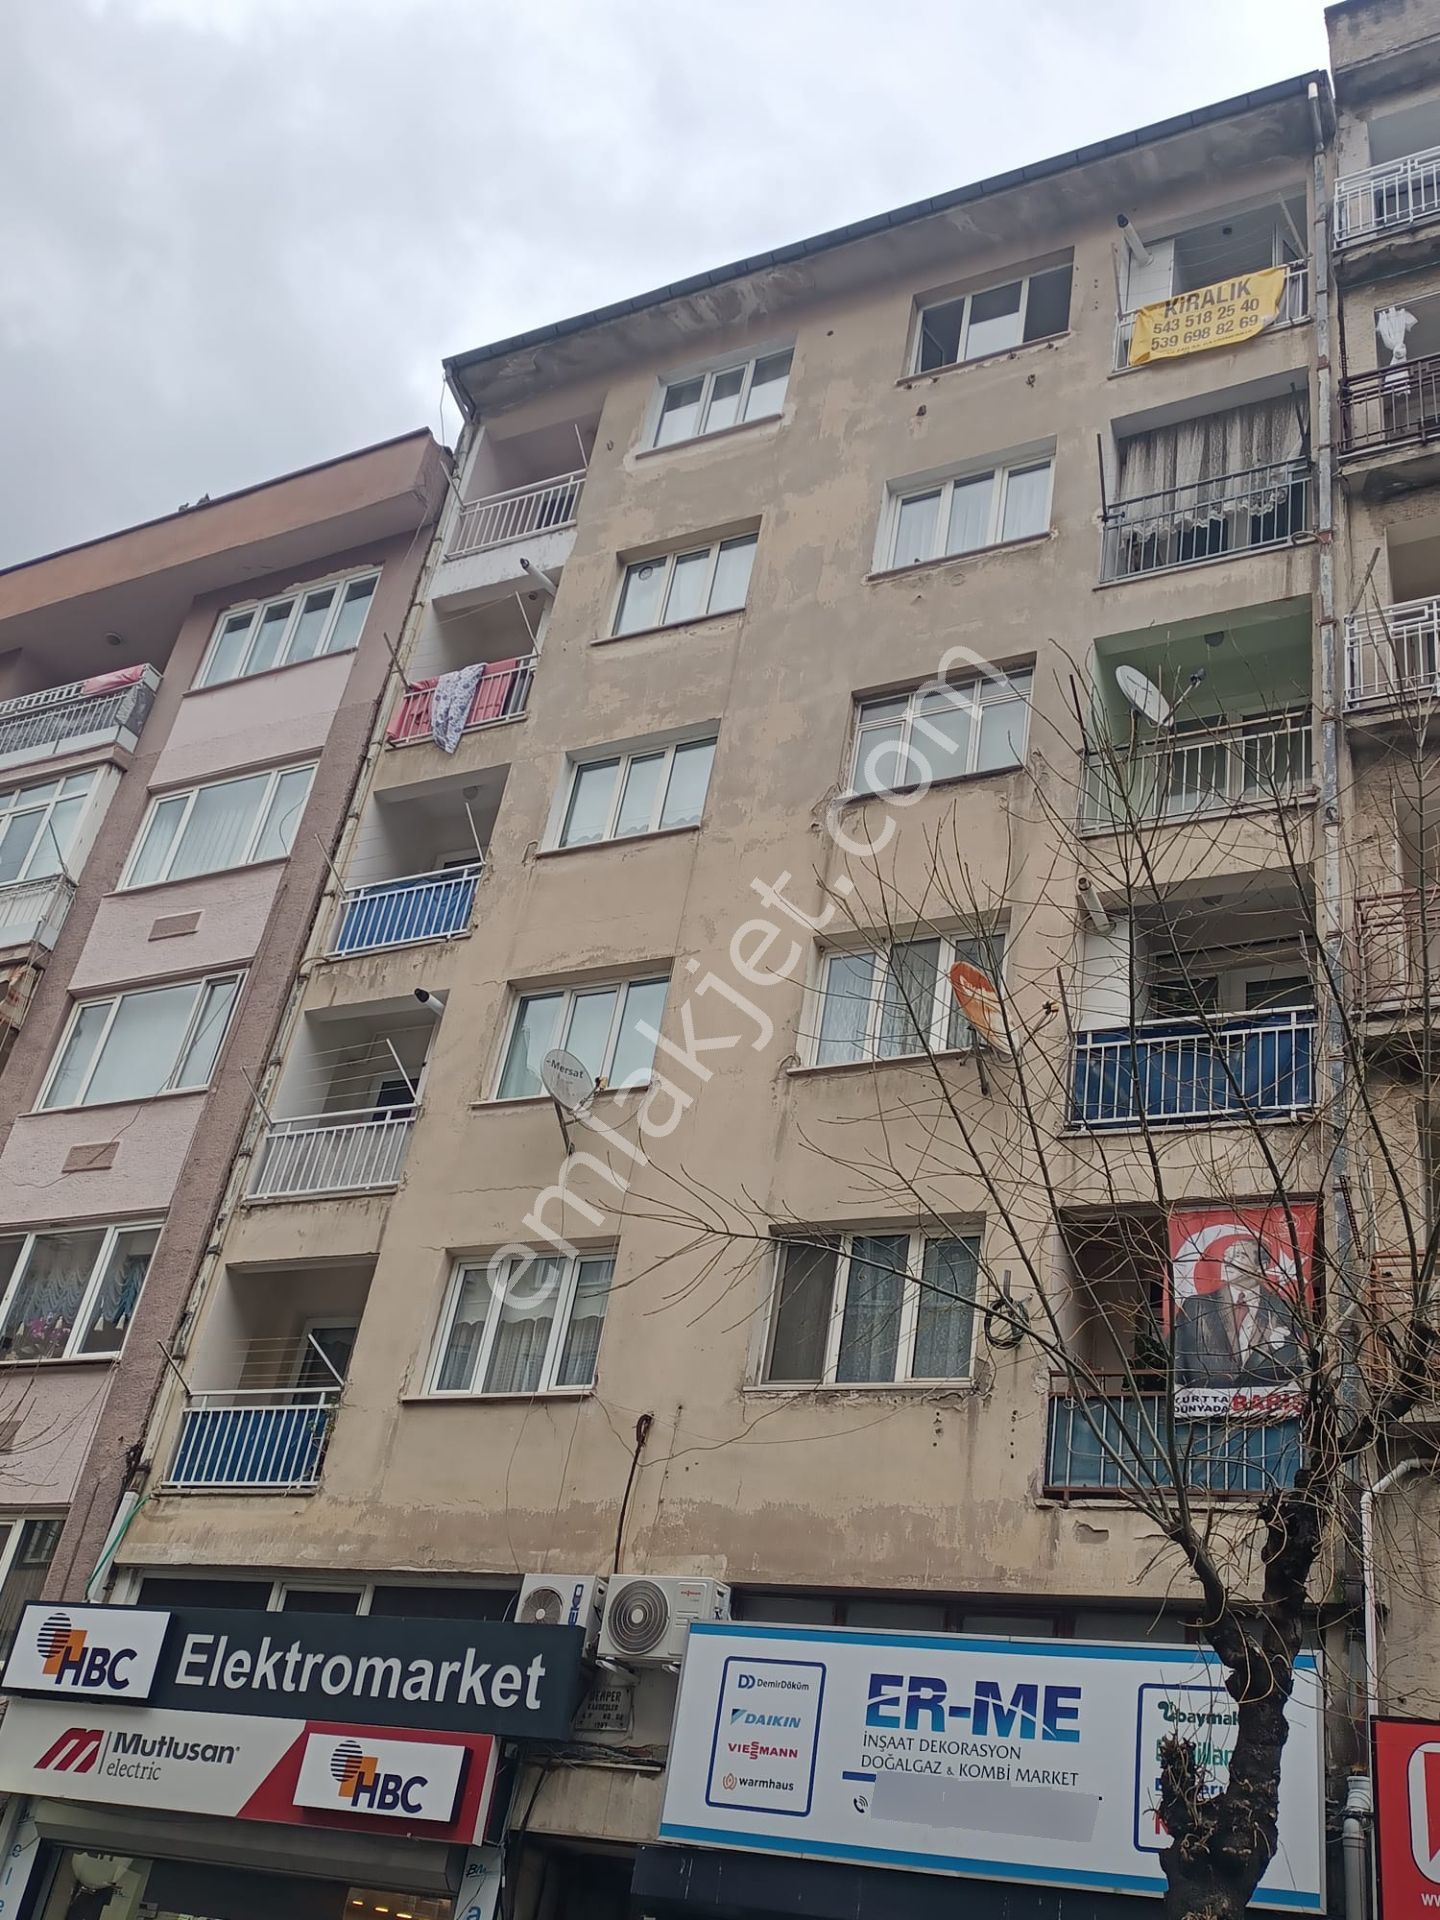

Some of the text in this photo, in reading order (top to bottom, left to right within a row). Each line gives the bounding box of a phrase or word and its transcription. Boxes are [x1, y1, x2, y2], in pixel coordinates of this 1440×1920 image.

[1153, 298, 1260, 334] 543 518 25 40
[1151, 335, 1179, 351] 539
[1183, 328, 1210, 344] 698
[1215, 321, 1234, 336] 82
[1239, 314, 1258, 329] 69
[568, 1584, 584, 1627] EKO
[55, 1633, 546, 1709] HBC Elektromarket
[757, 1679, 810, 1691] DemirDöküm
[745, 1713, 801, 1729] DAIKIN
[866, 1673, 1082, 1743] ER-ME
[111, 1731, 235, 1764] Mutlusan
[728, 1741, 798, 1760] VIESSMANN
[863, 1731, 1022, 1760] İNŞAAT DEKORASYON
[107, 1759, 161, 1781] electric
[739, 1777, 794, 1791] warmhaus
[861, 1754, 942, 1775] DOĞALGAZ
[959, 1763, 1011, 1781] KOMBİ
[1015, 1769, 1079, 1786] MARKET
[351, 1773, 428, 1814] HBC
